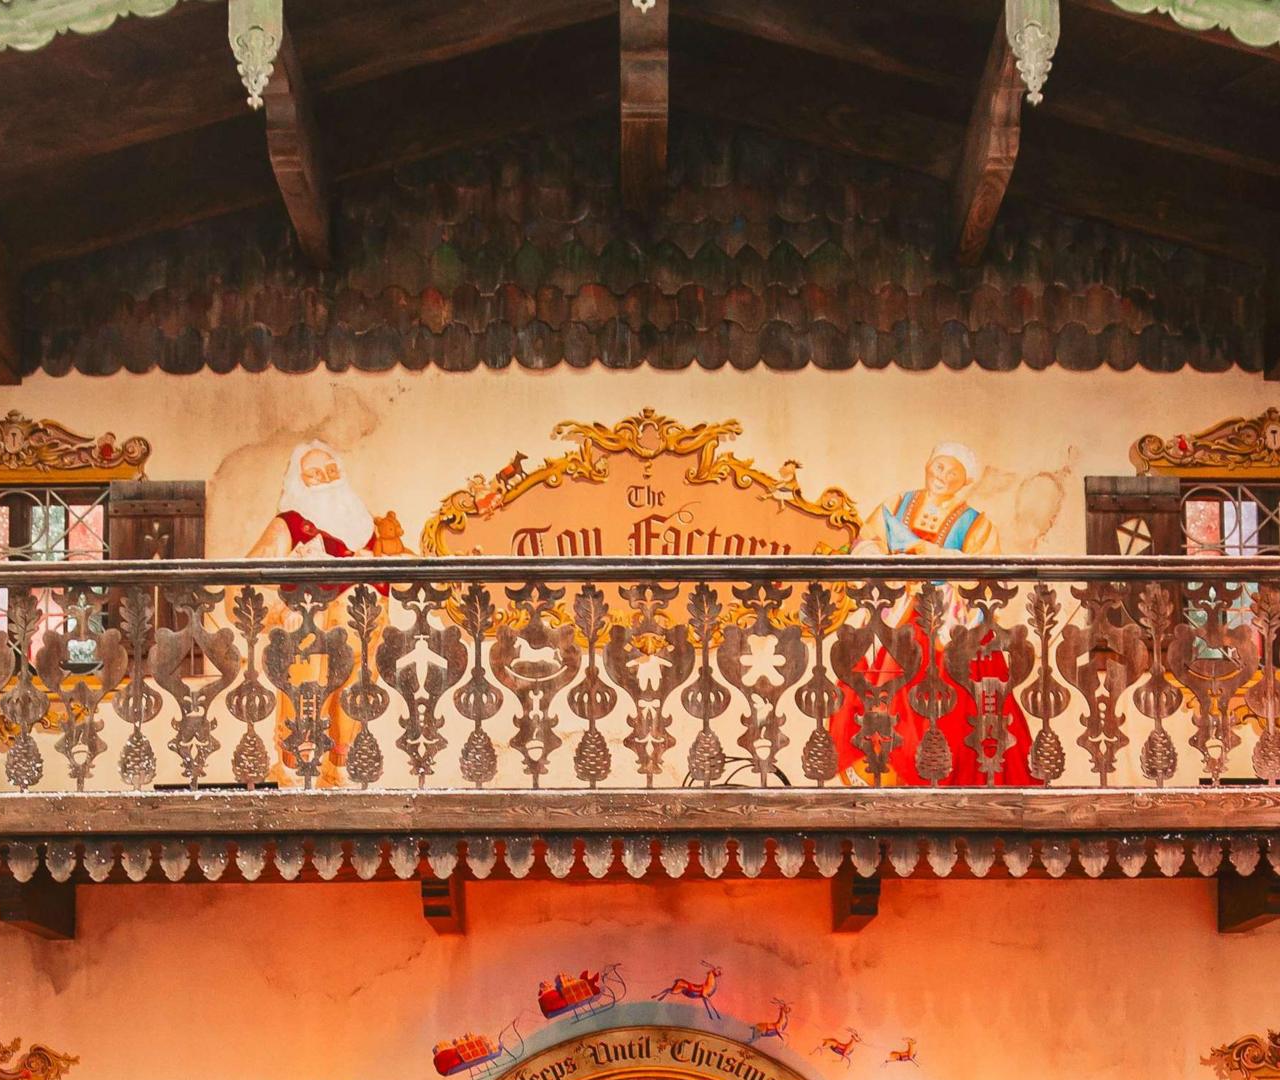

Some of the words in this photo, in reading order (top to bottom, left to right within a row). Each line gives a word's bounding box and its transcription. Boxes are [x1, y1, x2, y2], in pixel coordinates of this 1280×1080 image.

[626, 485, 667, 508] The
[510, 523, 604, 556] Toy
[627, 502, 792, 556] Factory
[587, 1036, 652, 1065] Until
